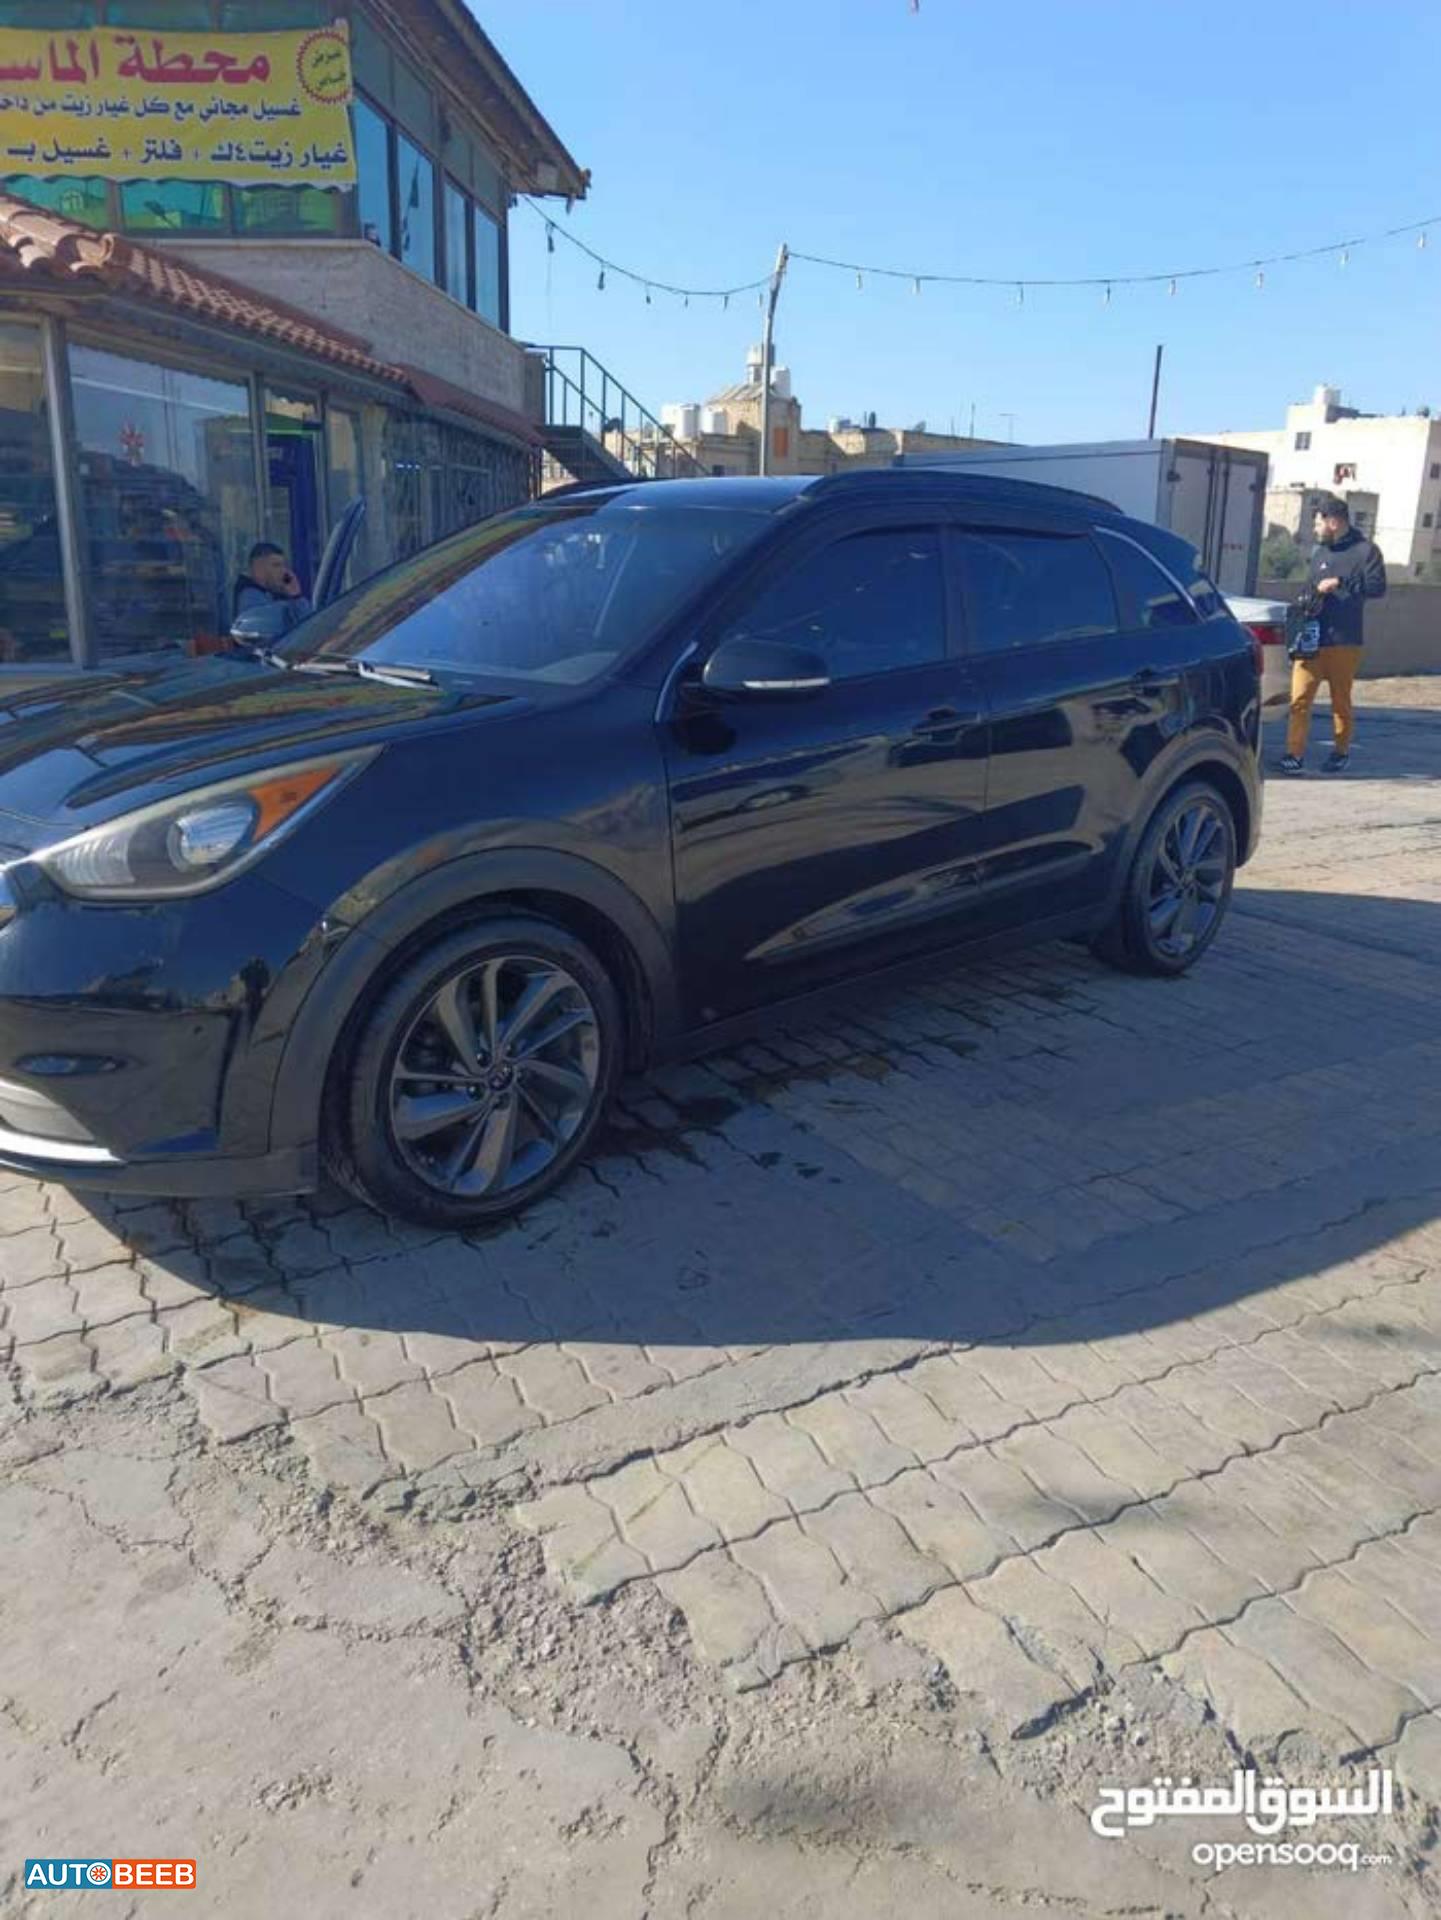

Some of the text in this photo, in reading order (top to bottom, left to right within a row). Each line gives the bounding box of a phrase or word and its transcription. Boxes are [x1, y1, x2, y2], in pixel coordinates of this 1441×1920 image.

[114, 34, 270, 84] محطة
[61, 94, 92, 116] زيت
[96, 95, 130, 118] غيار
[135, 96, 170, 118] كل
[174, 101, 195, 121] مع
[199, 96, 249, 122] مجاني
[253, 98, 302, 121] غسيل
[42, 136, 112, 164] غسيل
[139, 138, 183, 164] فلتر
[299, 141, 348, 170] غيار
